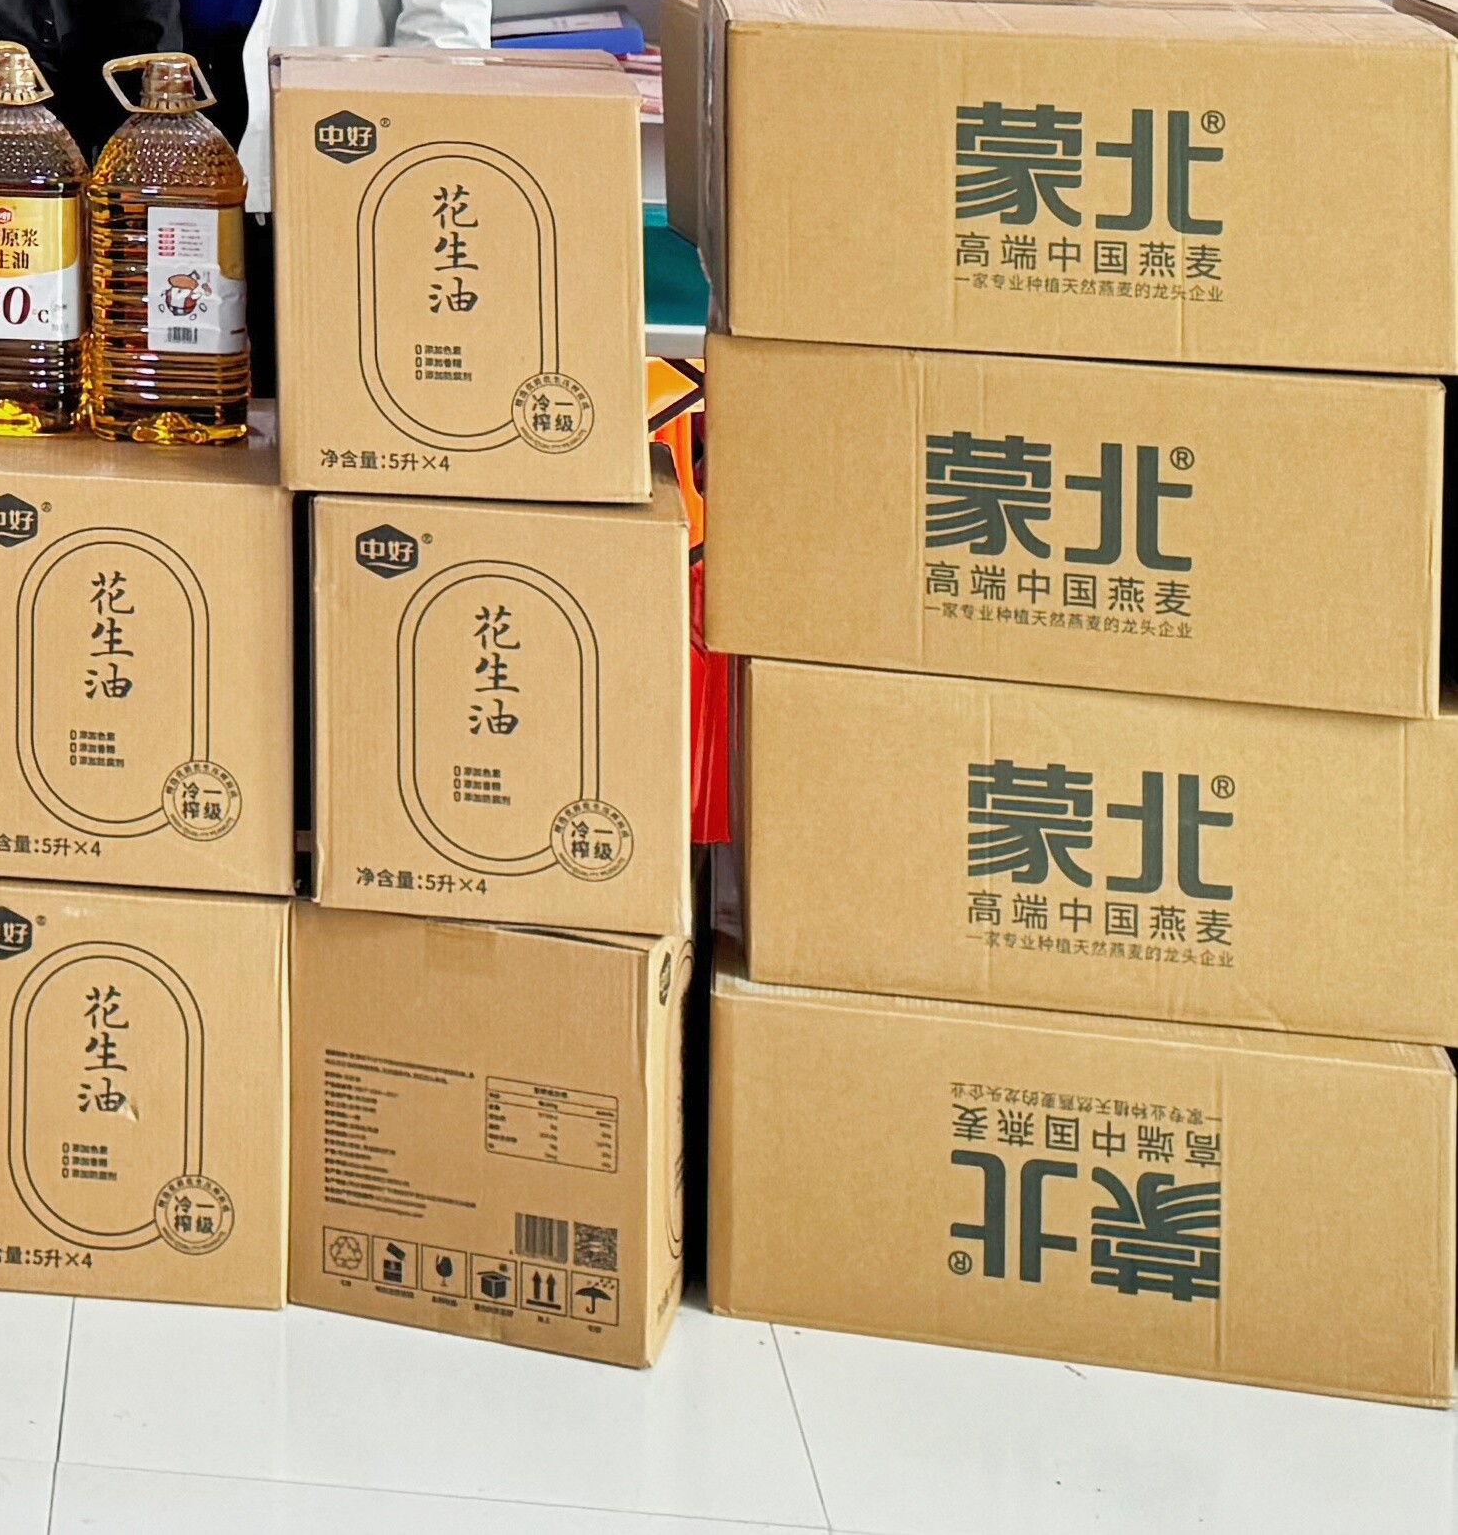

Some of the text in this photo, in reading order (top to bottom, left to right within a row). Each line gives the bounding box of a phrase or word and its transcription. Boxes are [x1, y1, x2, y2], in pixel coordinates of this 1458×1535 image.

[319, 125, 373, 148] 中好
[955, 101, 1224, 236] 蒙北
[429, 184, 479, 314] 花生油
[955, 231, 1223, 281] 高端中国燕麦
[360, 539, 414, 563] 中好
[925, 431, 1193, 572] 蒙北
[85, 571, 134, 700] 花生油
[925, 560, 1193, 618] 高端中国燕麦
[469, 605, 521, 735] 花生油
[967, 759, 1234, 901] 蒙北
[967, 889, 1234, 947] 高端中国燕麦
[78, 985, 129, 1114] 花生油
[950, 1102, 1222, 1168] 高端中国燕麦
[950, 1149, 1222, 1304] 蒙北
